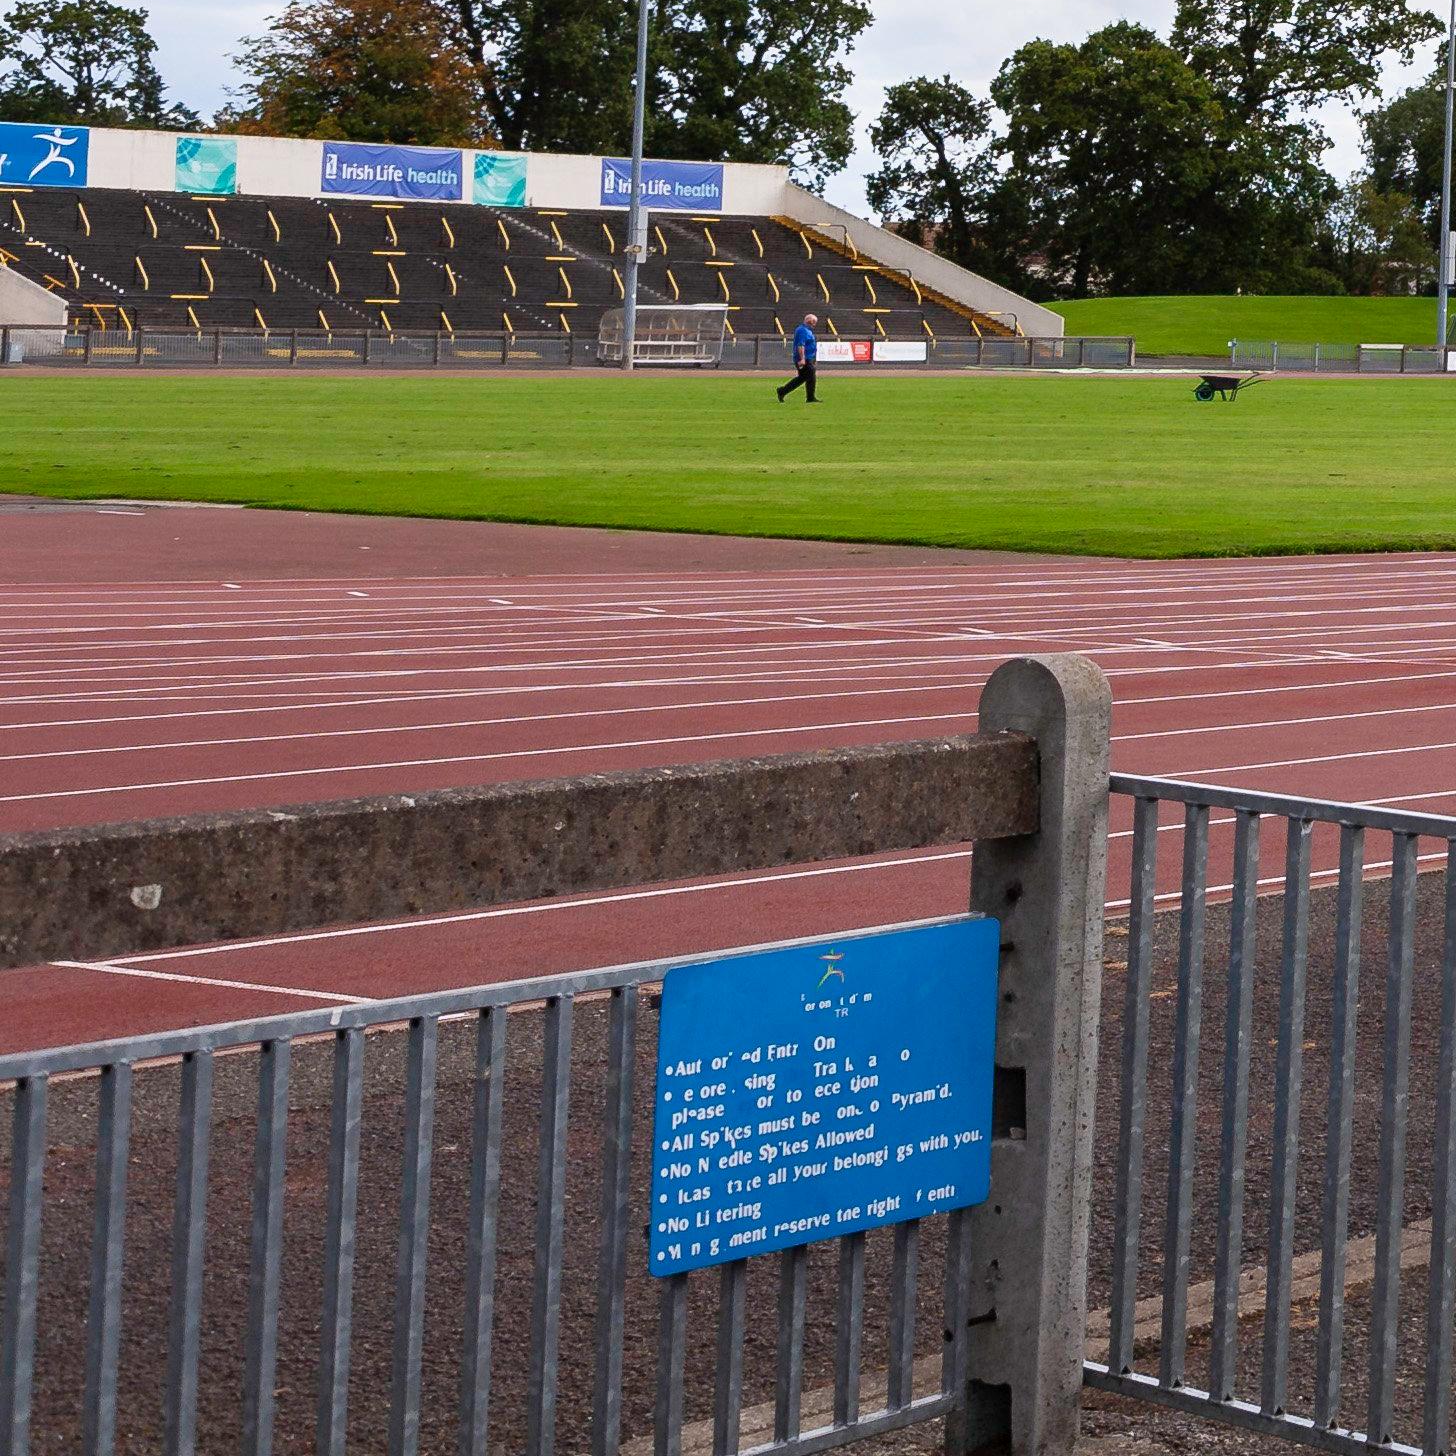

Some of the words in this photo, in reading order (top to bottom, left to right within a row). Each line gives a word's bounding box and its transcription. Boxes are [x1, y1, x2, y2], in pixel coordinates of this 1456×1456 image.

[342, 163, 374, 181] Irish
[376, 163, 403, 182] Life
[407, 167, 458, 185] health
[648, 179, 672, 196] Life
[675, 181, 719, 198] health
[671, 1134, 694, 1152] All
[700, 1124, 752, 1149] Spkes
[758, 1115, 795, 1136] must
[802, 1111, 821, 1126] be
[892, 1083, 952, 1110] Pyramd.
[670, 1162, 691, 1179] No
[698, 1150, 752, 1174] Nedle
[759, 1139, 809, 1164] Spkes
[815, 1124, 875, 1149] Allowed
[768, 1168, 787, 1185] all
[793, 1161, 827, 1182] your
[834, 1143, 913, 1172] belongigs
[920, 1134, 948, 1153] with
[954, 1129, 983, 1149] you.
[668, 1217, 689, 1234] No
[696, 1202, 762, 1228] Litering
[867, 1195, 901, 1218] right
